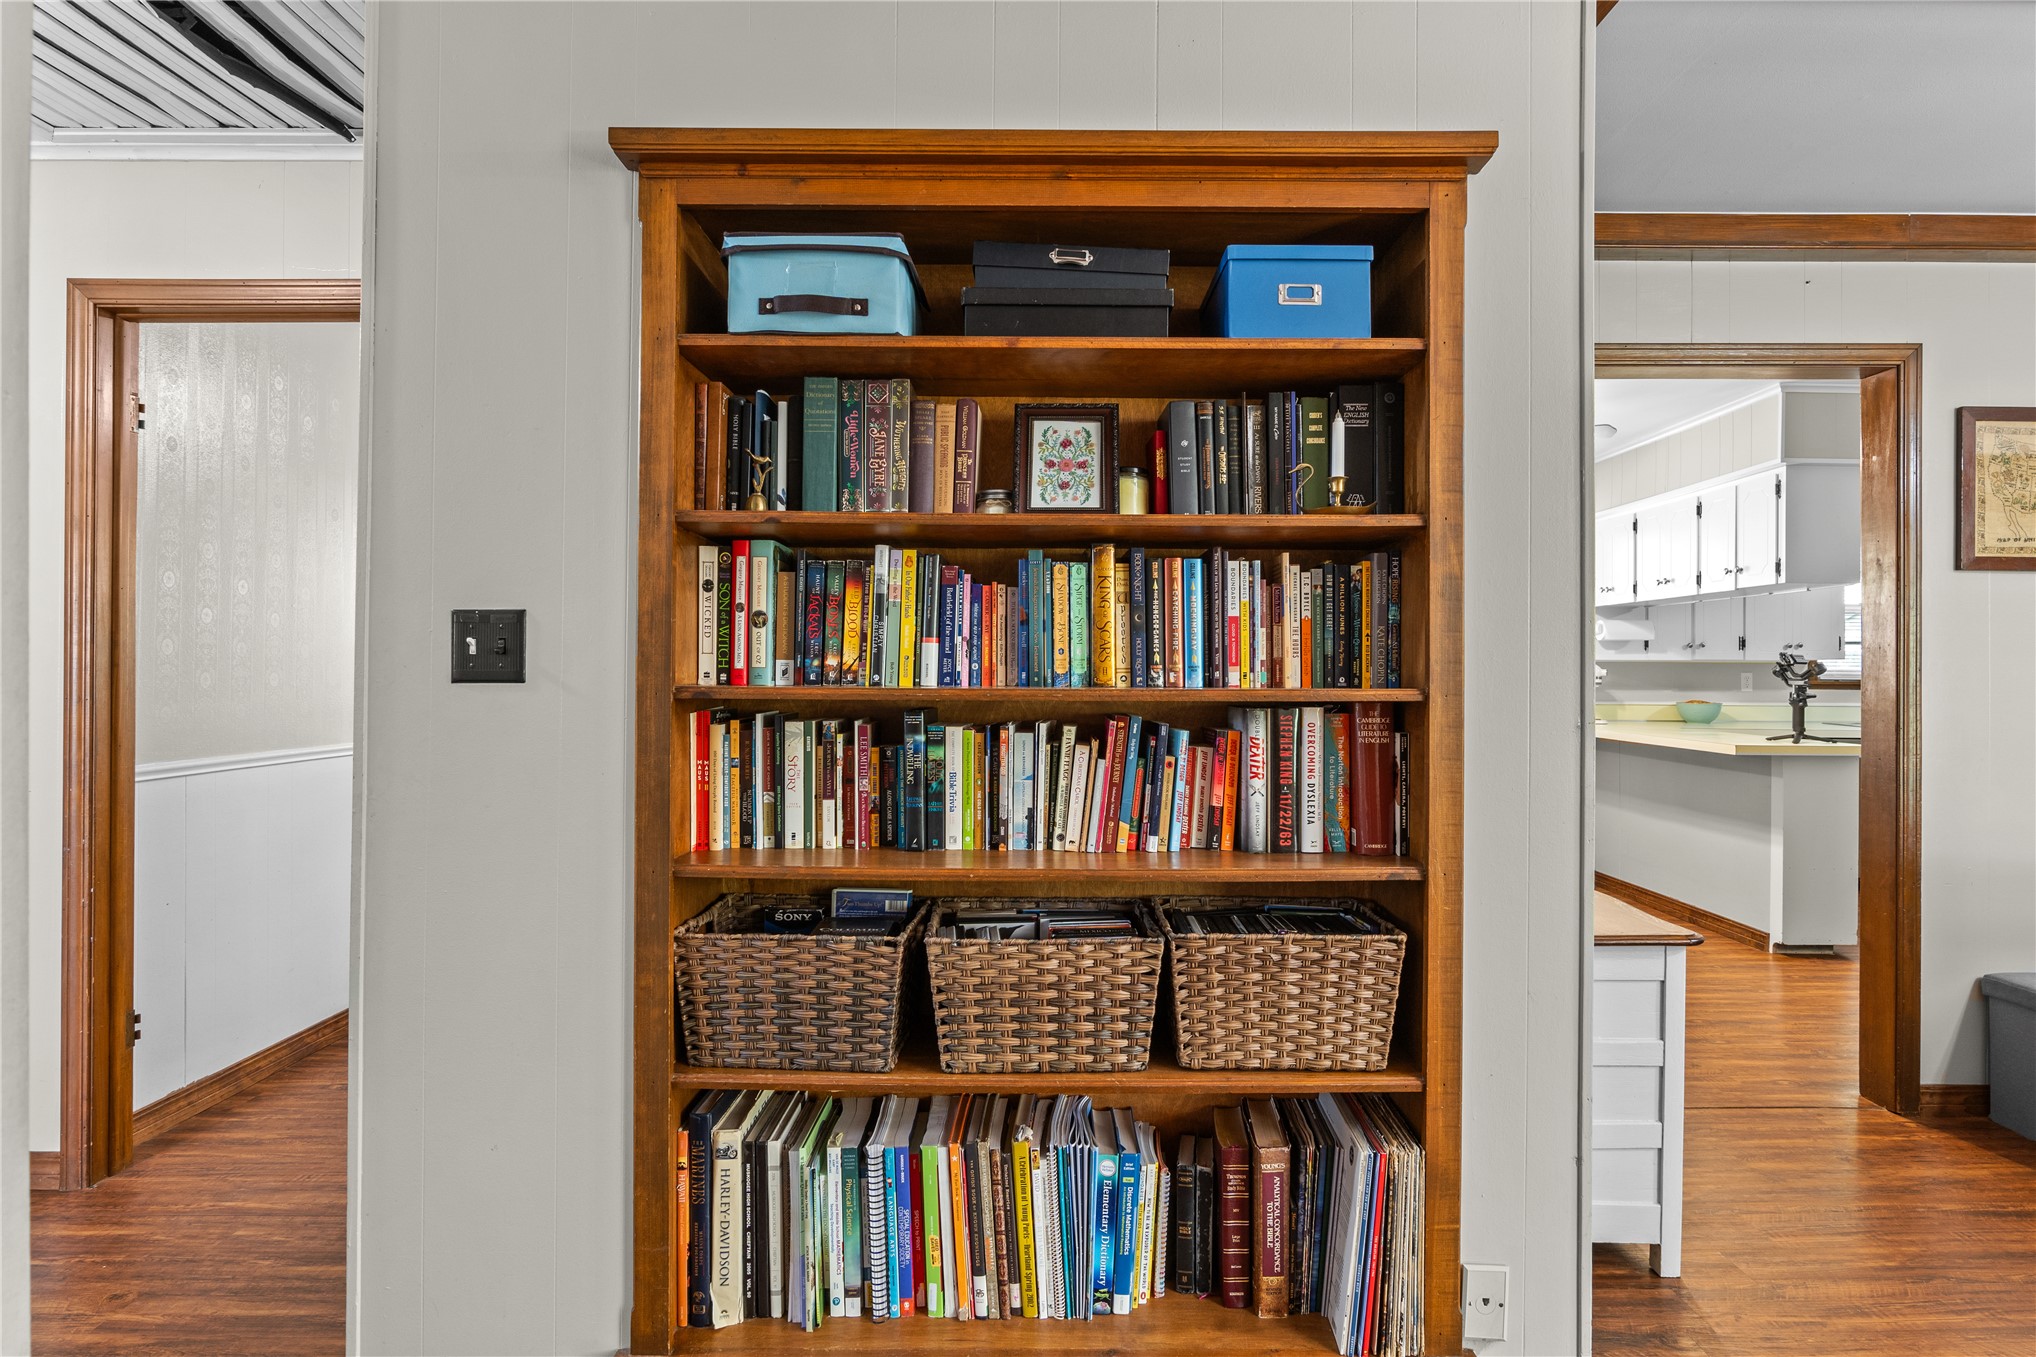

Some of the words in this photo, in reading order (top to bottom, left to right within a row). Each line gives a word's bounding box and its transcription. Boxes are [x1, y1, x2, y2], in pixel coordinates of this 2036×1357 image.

[845, 410, 859, 436] Little
[940, 425, 949, 442] PUBLIC
[868, 427, 887, 457] JANE
[893, 420, 907, 460] WUTHERING
[850, 437, 860, 478] Women
[940, 444, 949, 468] SPEAKING
[868, 458, 887, 487] EYRE
[894, 460, 907, 491] HEIGHTS
[1254, 486, 1262, 514] RIVERS
[719, 583, 729, 610] SON
[945, 587, 953, 617] Battlefield
[1073, 583, 1084, 608] SIEGE
[1097, 575, 1111, 609] KING
[1133, 576, 1142, 601] NIGHT
[704, 595, 712, 638] WICKED
[807, 594, 822, 638] JACKALS
[827, 592, 842, 640] BONES
[846, 598, 862, 638] BLOOD
[1075, 616, 1084, 645] STORM
[718, 623, 729, 668] WITCH
[1096, 620, 1112, 663] SCARS
[1376, 626, 1385, 648] KATE
[756, 655, 761, 664] OZ
[1377, 648, 1385, 684] CHOPIN
[860, 736, 868, 750] LEE
[1063, 737, 1071, 758] FANNIE
[1280, 715, 1293, 757] STEPHEN
[906, 738, 914, 784] INDWELLING
[1307, 722, 1315, 780] OVERCOMING
[786, 755, 800, 792] STORY
[949, 772, 957, 791] Bible
[1200, 762, 1208, 781] LINDSAY
[1280, 761, 1293, 784] KING
[1307, 783, 1315, 825] DYSLEXIA
[1279, 794, 1292, 846] 11/22/63
[775, 910, 812, 921] SONY
[676, 1174, 686, 1203] HAWAII
[691, 1145, 706, 1205] MARINES
[1018, 1160, 1027, 1194] Celebration
[845, 1179, 853, 1207] Physical
[1100, 1179, 1112, 1234] Elementary
[1125, 1186, 1133, 1214] Discrete
[1267, 1202, 1274, 1211] TO
[888, 1196, 896, 1237] LANGUAGE
[1020, 1204, 1028, 1221] Young
[719, 1168, 731, 1287] HARLEY-DAVIDSON
[1022, 1223, 1031, 1239] Poets
[1123, 1215, 1131, 1255] Mathematics
[1024, 1244, 1033, 1271] Heartland
[1098, 1236, 1110, 1286] Dictionary
[1024, 1272, 1034, 1292] Spring
[1026, 1293, 1034, 1308] 2002
